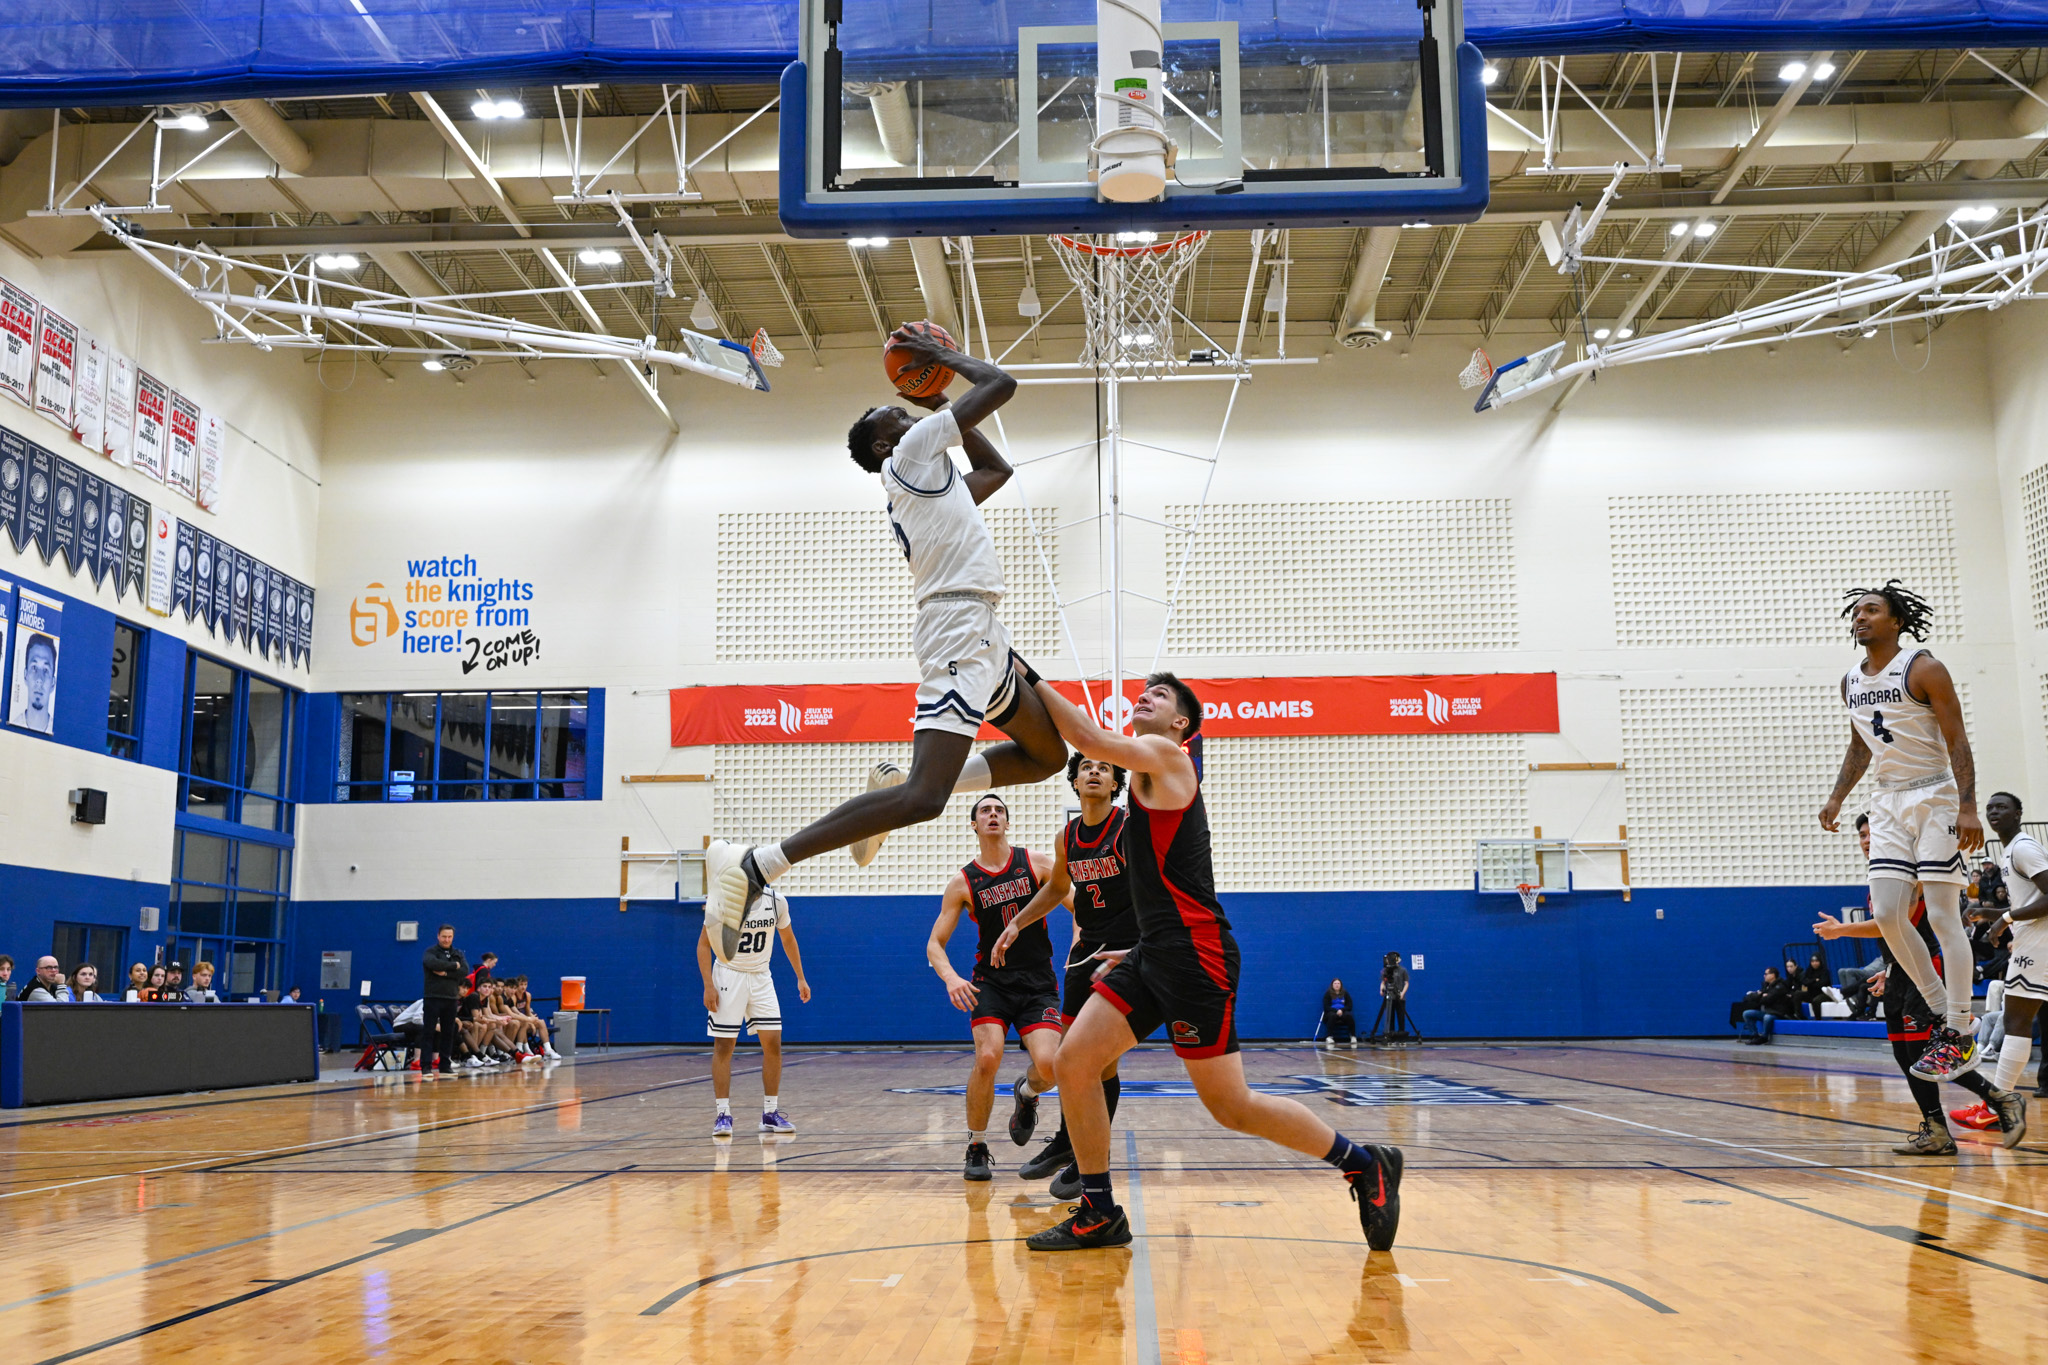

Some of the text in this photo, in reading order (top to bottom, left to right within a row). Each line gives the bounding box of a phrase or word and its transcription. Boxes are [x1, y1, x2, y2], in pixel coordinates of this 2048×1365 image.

[1, 300, 32, 332] OCAA
[0, 315, 32, 346] CHAMPIONS
[7, 333, 22, 348] MEN'S
[8, 343, 20, 356] GOLF
[44, 328, 72, 358] OCAA
[42, 343, 72, 371] CHAMPIONS
[52, 361, 61, 373] GOLF
[0, 371, 24, 392] 016-2017
[40, 394, 66, 415] 2016-2017
[140, 388, 164, 414] OCAA
[138, 402, 164, 427] CHAMPIONS
[172, 410, 196, 435] OCAA
[171, 423, 196, 446] CHAMPIONS
[177, 532, 194, 549] Curling
[180, 524, 194, 538] Mixed
[407, 554, 477, 578] watch
[405, 578, 534, 606] the knights
[20, 598, 38, 616] JORDI
[404, 604, 529, 628] score from
[18, 613, 46, 631] AMORES
[402, 630, 462, 654] here!
[482, 629, 536, 656] COME
[486, 638, 540, 671] ON UP!
[948, 660, 958, 676] 5
[1203, 700, 1314, 720] DA GAMES
[1390, 704, 1424, 716] 2022
[1849, 688, 1902, 710] NIAGARA
[744, 714, 776, 726] 2022
[1870, 710, 1894, 744] 4
[978, 876, 1032, 909] FANSHAWE
[1086, 884, 1106, 908] 2
[744, 918, 775, 928] AGARA
[1001, 902, 1020, 928] 10
[738, 931, 767, 953] 20
